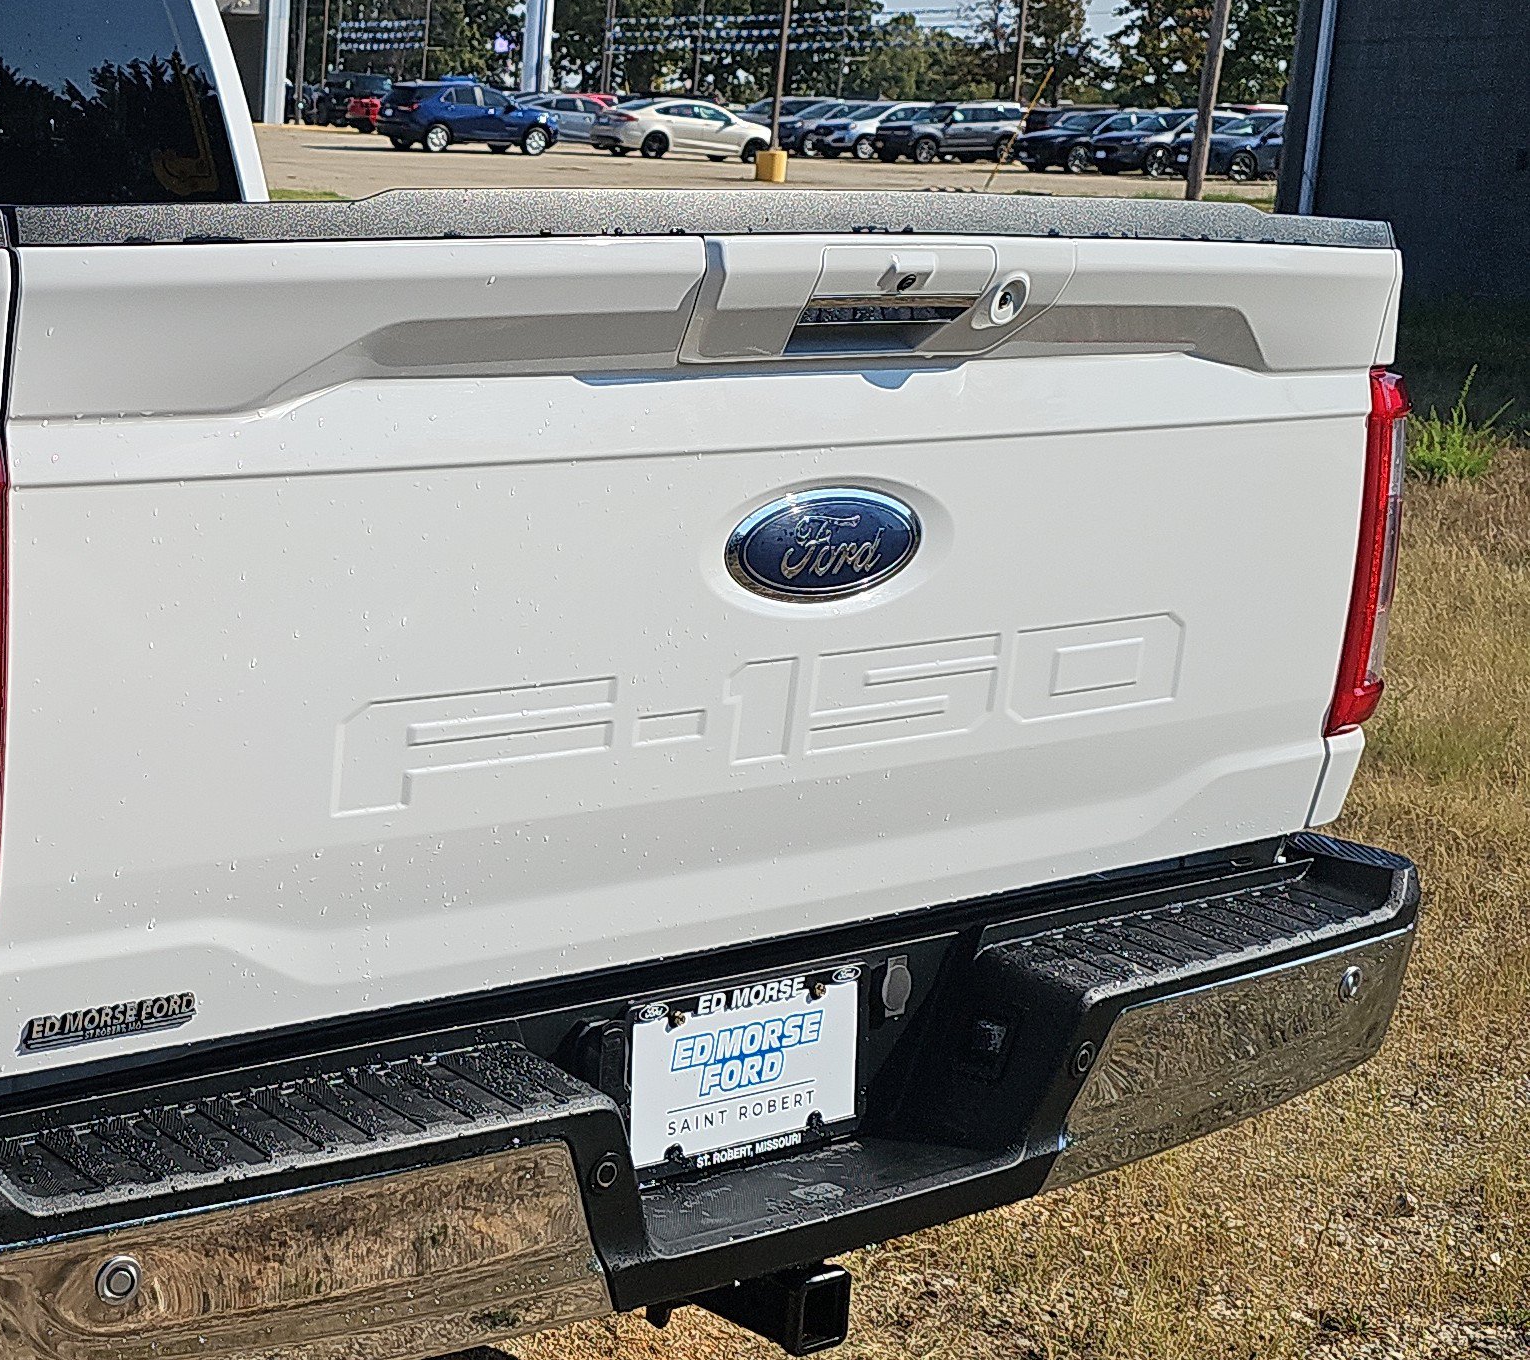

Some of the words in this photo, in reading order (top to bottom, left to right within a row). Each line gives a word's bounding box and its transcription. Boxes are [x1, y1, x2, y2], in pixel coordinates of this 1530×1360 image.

[780, 514, 885, 579] Ford
[329, 611, 1186, 818] F-150
[31, 1016, 61, 1039] ED
[64, 1001, 139, 1034] MORSE
[141, 992, 195, 1020] FORD
[698, 992, 726, 1014] ED
[730, 976, 806, 1006] MORSE
[671, 1033, 715, 1071] ED
[715, 1010, 823, 1061] MORSE
[699, 1049, 784, 1097] FORD
[667, 1109, 728, 1136] SAINT
[738, 1090, 815, 1121] ROBERT
[696, 1154, 711, 1169] ST.
[713, 1144, 753, 1164] ROBERT,
[755, 1133, 802, 1154] MISSOURI
